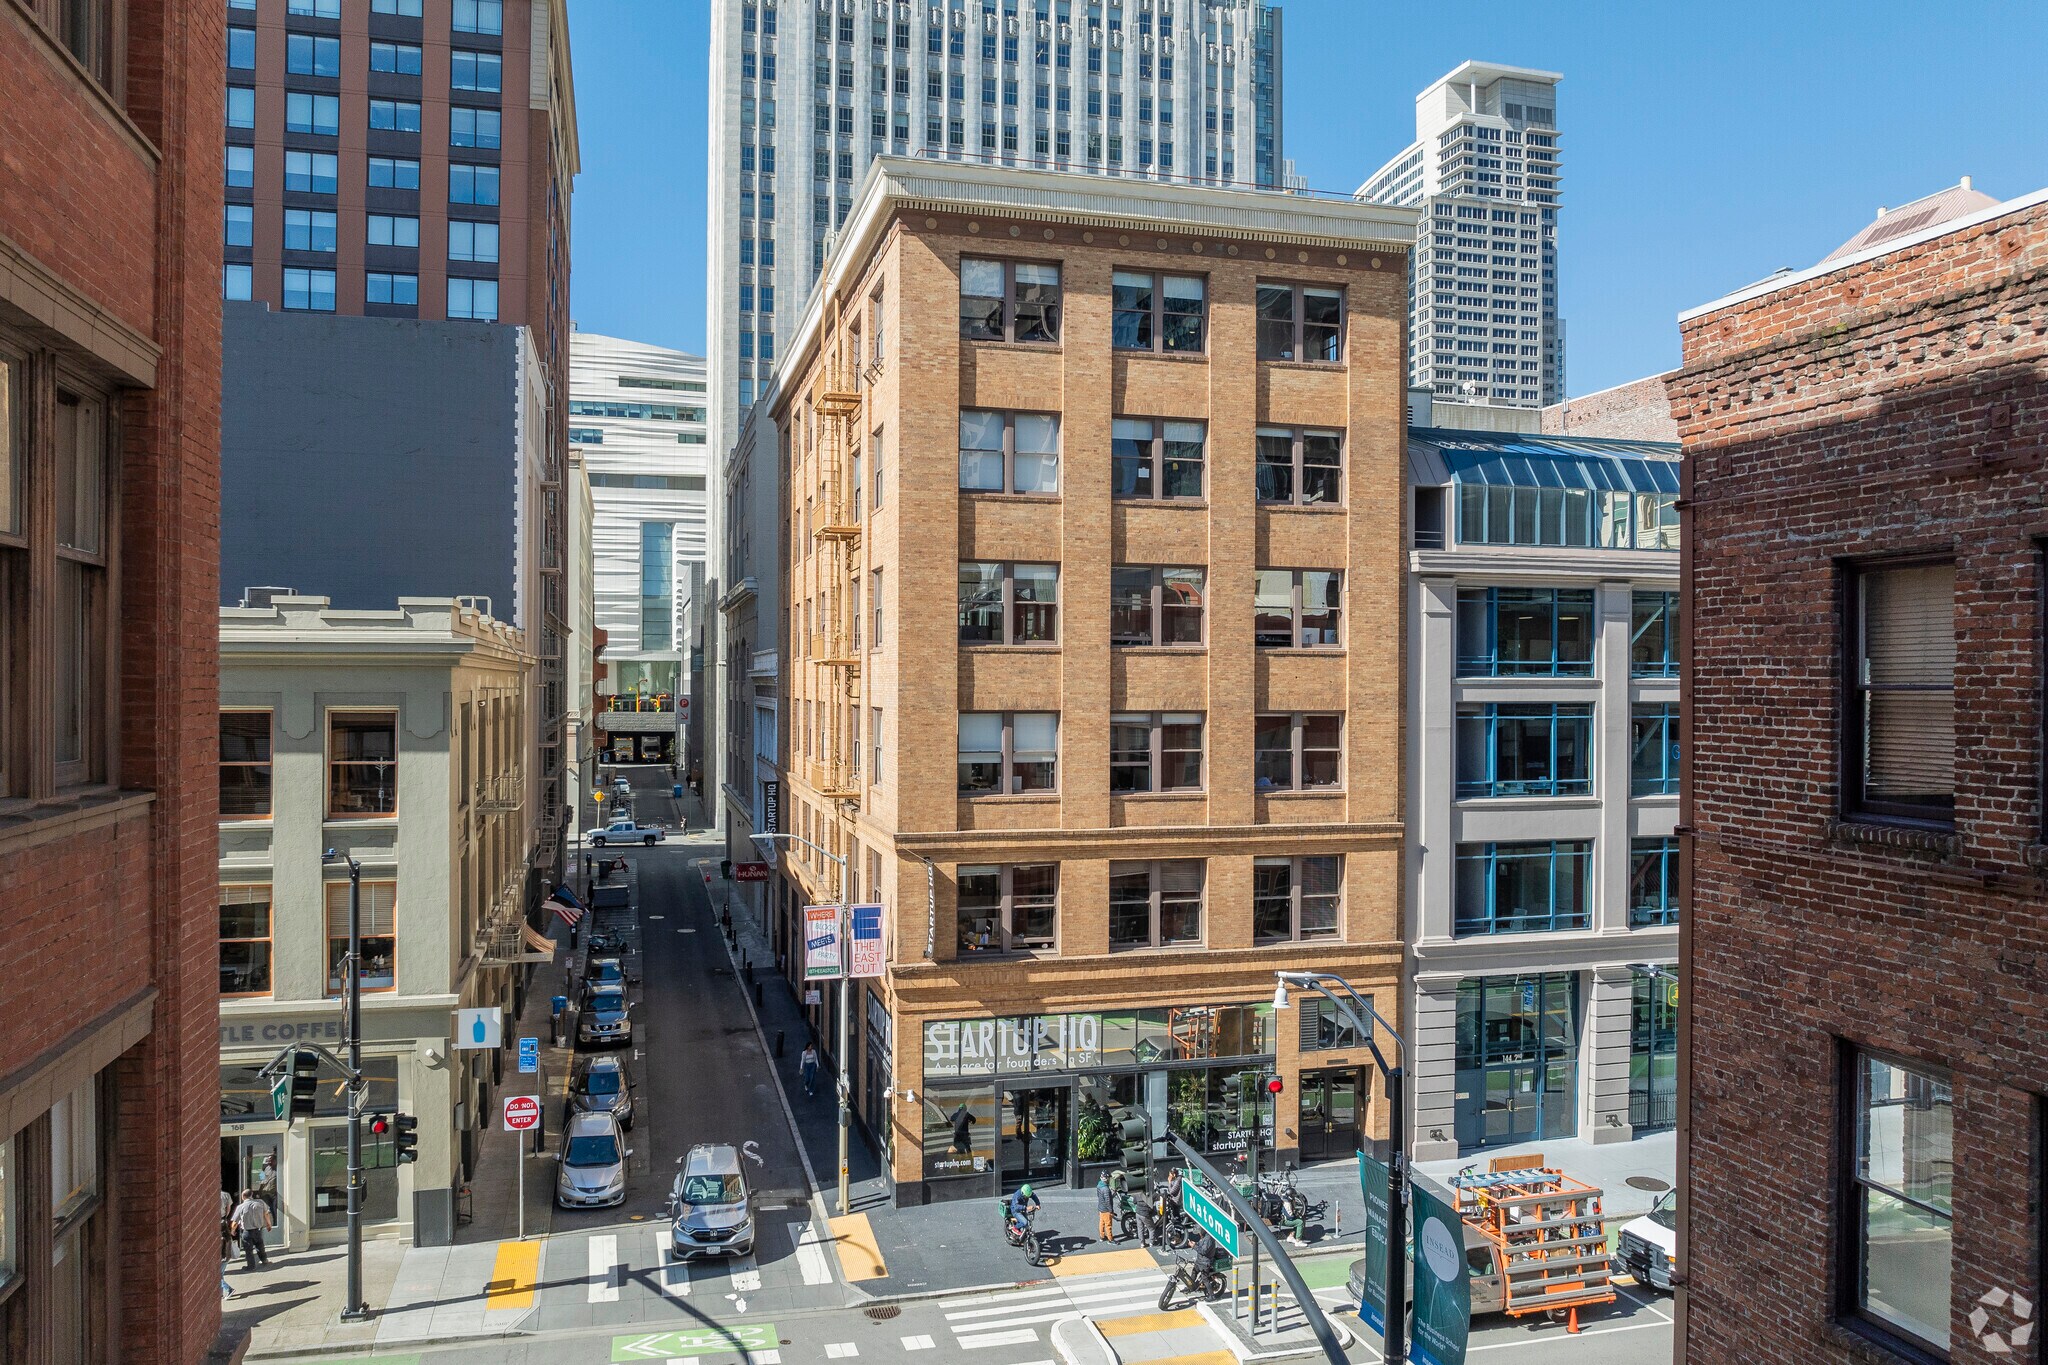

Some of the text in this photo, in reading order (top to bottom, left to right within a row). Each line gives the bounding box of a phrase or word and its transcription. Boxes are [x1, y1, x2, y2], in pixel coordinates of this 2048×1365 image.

[767, 784, 777, 832] STARTUP HQ
[738, 870, 768, 878] HUNAN
[810, 911, 833, 919] WHERE
[927, 888, 935, 954] STARTUP
[811, 937, 833, 948] MEETS
[854, 942, 875, 952] THE
[817, 951, 837, 959] PARTY
[854, 952, 881, 963] EAST
[854, 963, 877, 974] CUT
[928, 1019, 1048, 1061] STARTUP
[1059, 1015, 1098, 1053] HQ
[984, 1058, 1001, 1069] for
[1006, 1055, 1057, 1069] founders
[1078, 1052, 1092, 1064] SF
[511, 1116, 532, 1124] ENTER
[1260, 1128, 1272, 1137] HQ
[934, 1158, 971, 1169] startuphq.com
[1189, 1193, 1230, 1244] Natoma
[1426, 1234, 1455, 1259] INSEAD
[1417, 1316, 1460, 1353] The Business School
